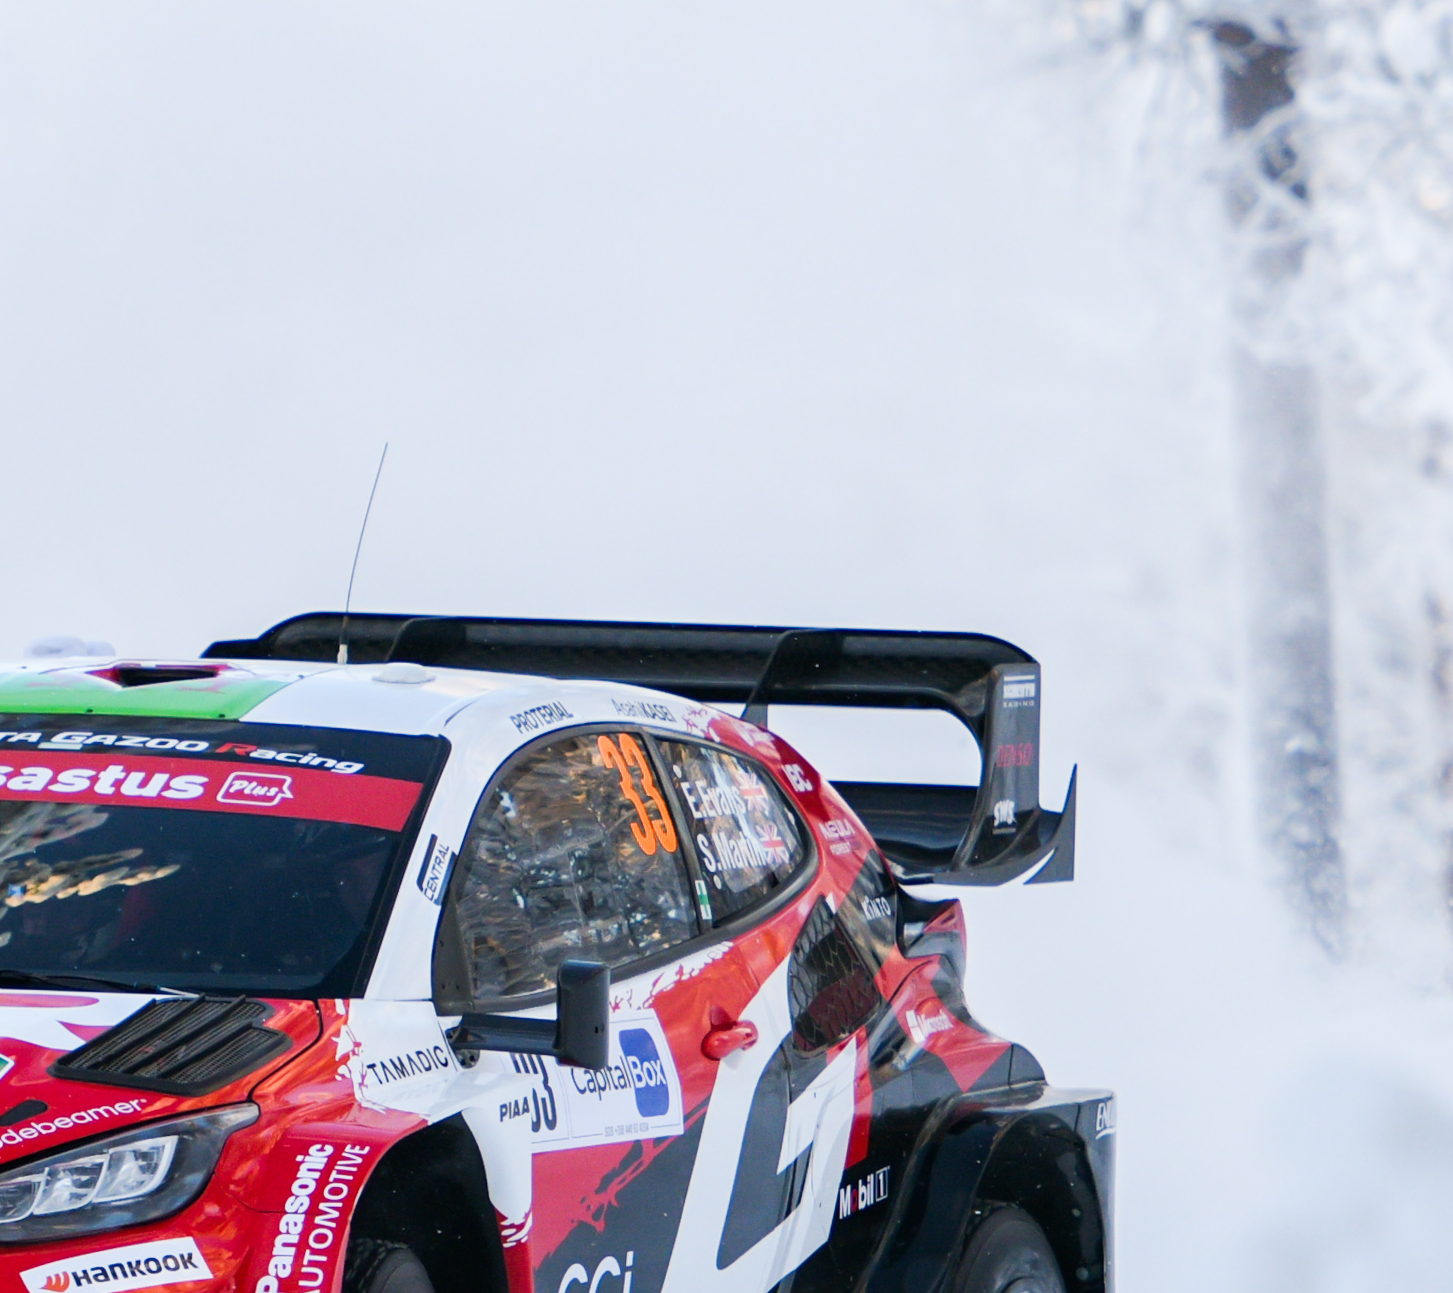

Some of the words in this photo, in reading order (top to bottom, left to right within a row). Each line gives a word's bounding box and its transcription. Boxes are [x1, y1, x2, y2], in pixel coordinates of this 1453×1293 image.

[508, 700, 575, 735] PROTERIAL
[48, 731, 210, 752] GAZOO
[214, 742, 366, 775] Racing
[228, 779, 281, 798] Plus
[596, 732, 678, 856] 33
[423, 842, 450, 902] CENTRAL
[366, 1045, 450, 1085] TAMADIC
[499, 1095, 530, 1123] PIAA
[838, 1173, 875, 1220] Mobil
